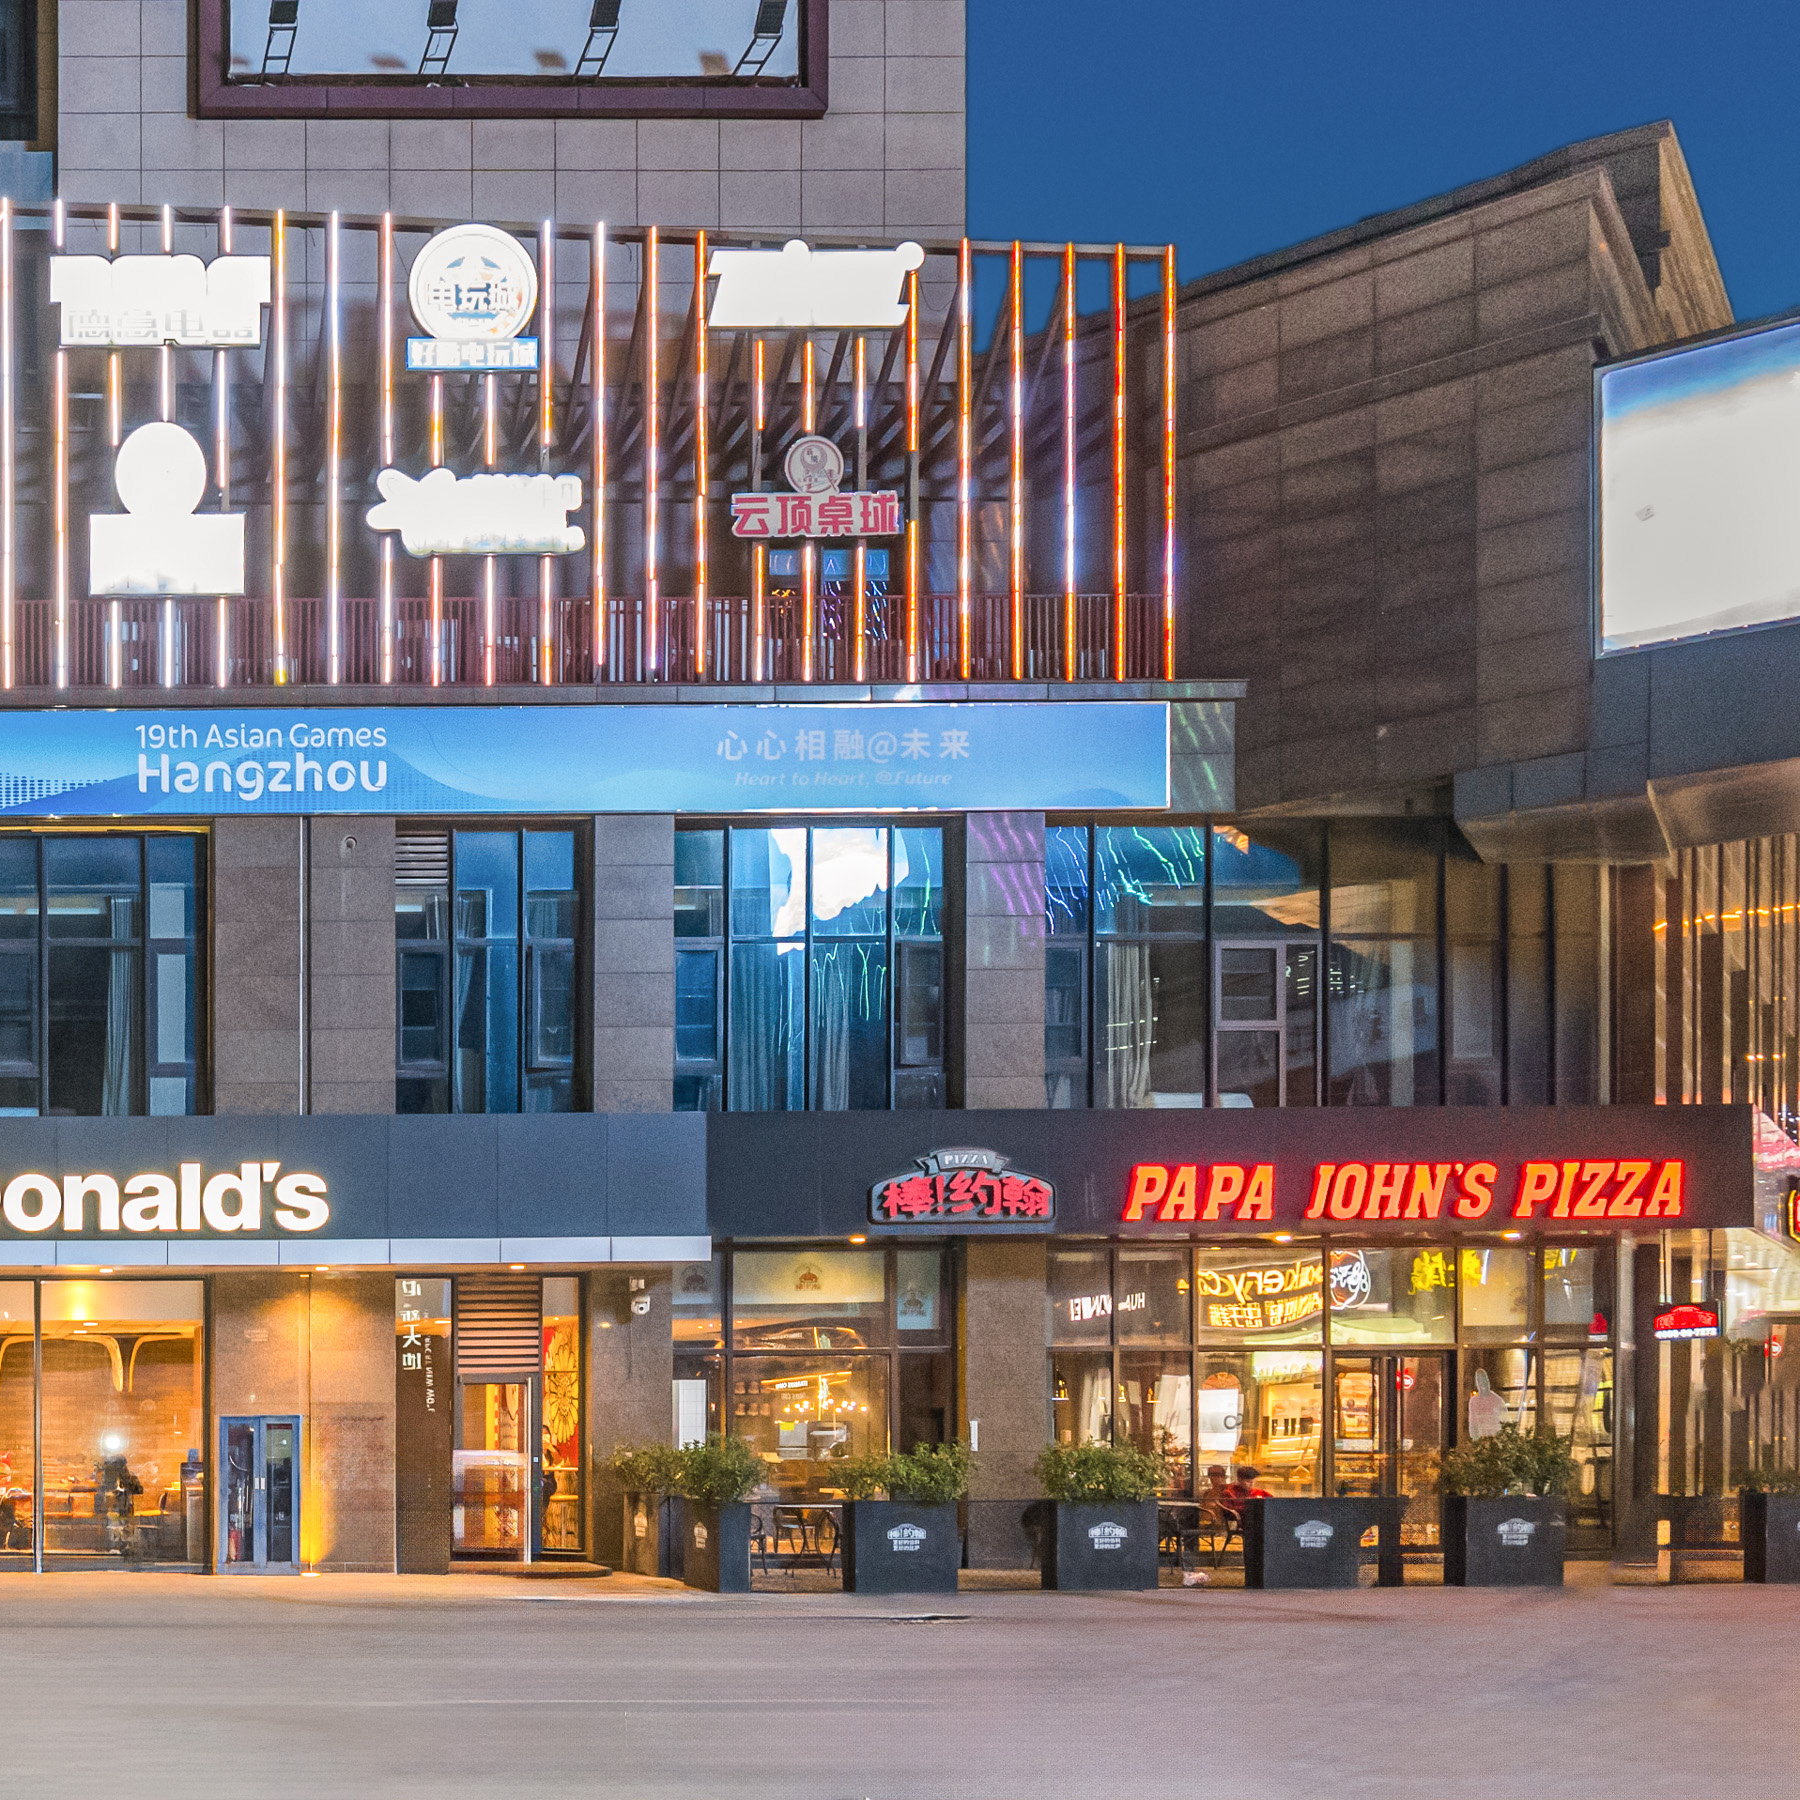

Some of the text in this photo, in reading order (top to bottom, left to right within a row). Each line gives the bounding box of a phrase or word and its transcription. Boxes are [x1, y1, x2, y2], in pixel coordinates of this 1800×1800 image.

[734, 494, 898, 535] 云顶桌球
[135, 723, 387, 748] 19th Asian Games
[138, 752, 387, 801] Hangzhou
[734, 772, 786, 785] Heart
[792, 773, 809, 785] to
[883, 1170, 1052, 1217] 棒!约翰
[1121, 1158, 1685, 1222] PAPA JOHN'S PIZZA
